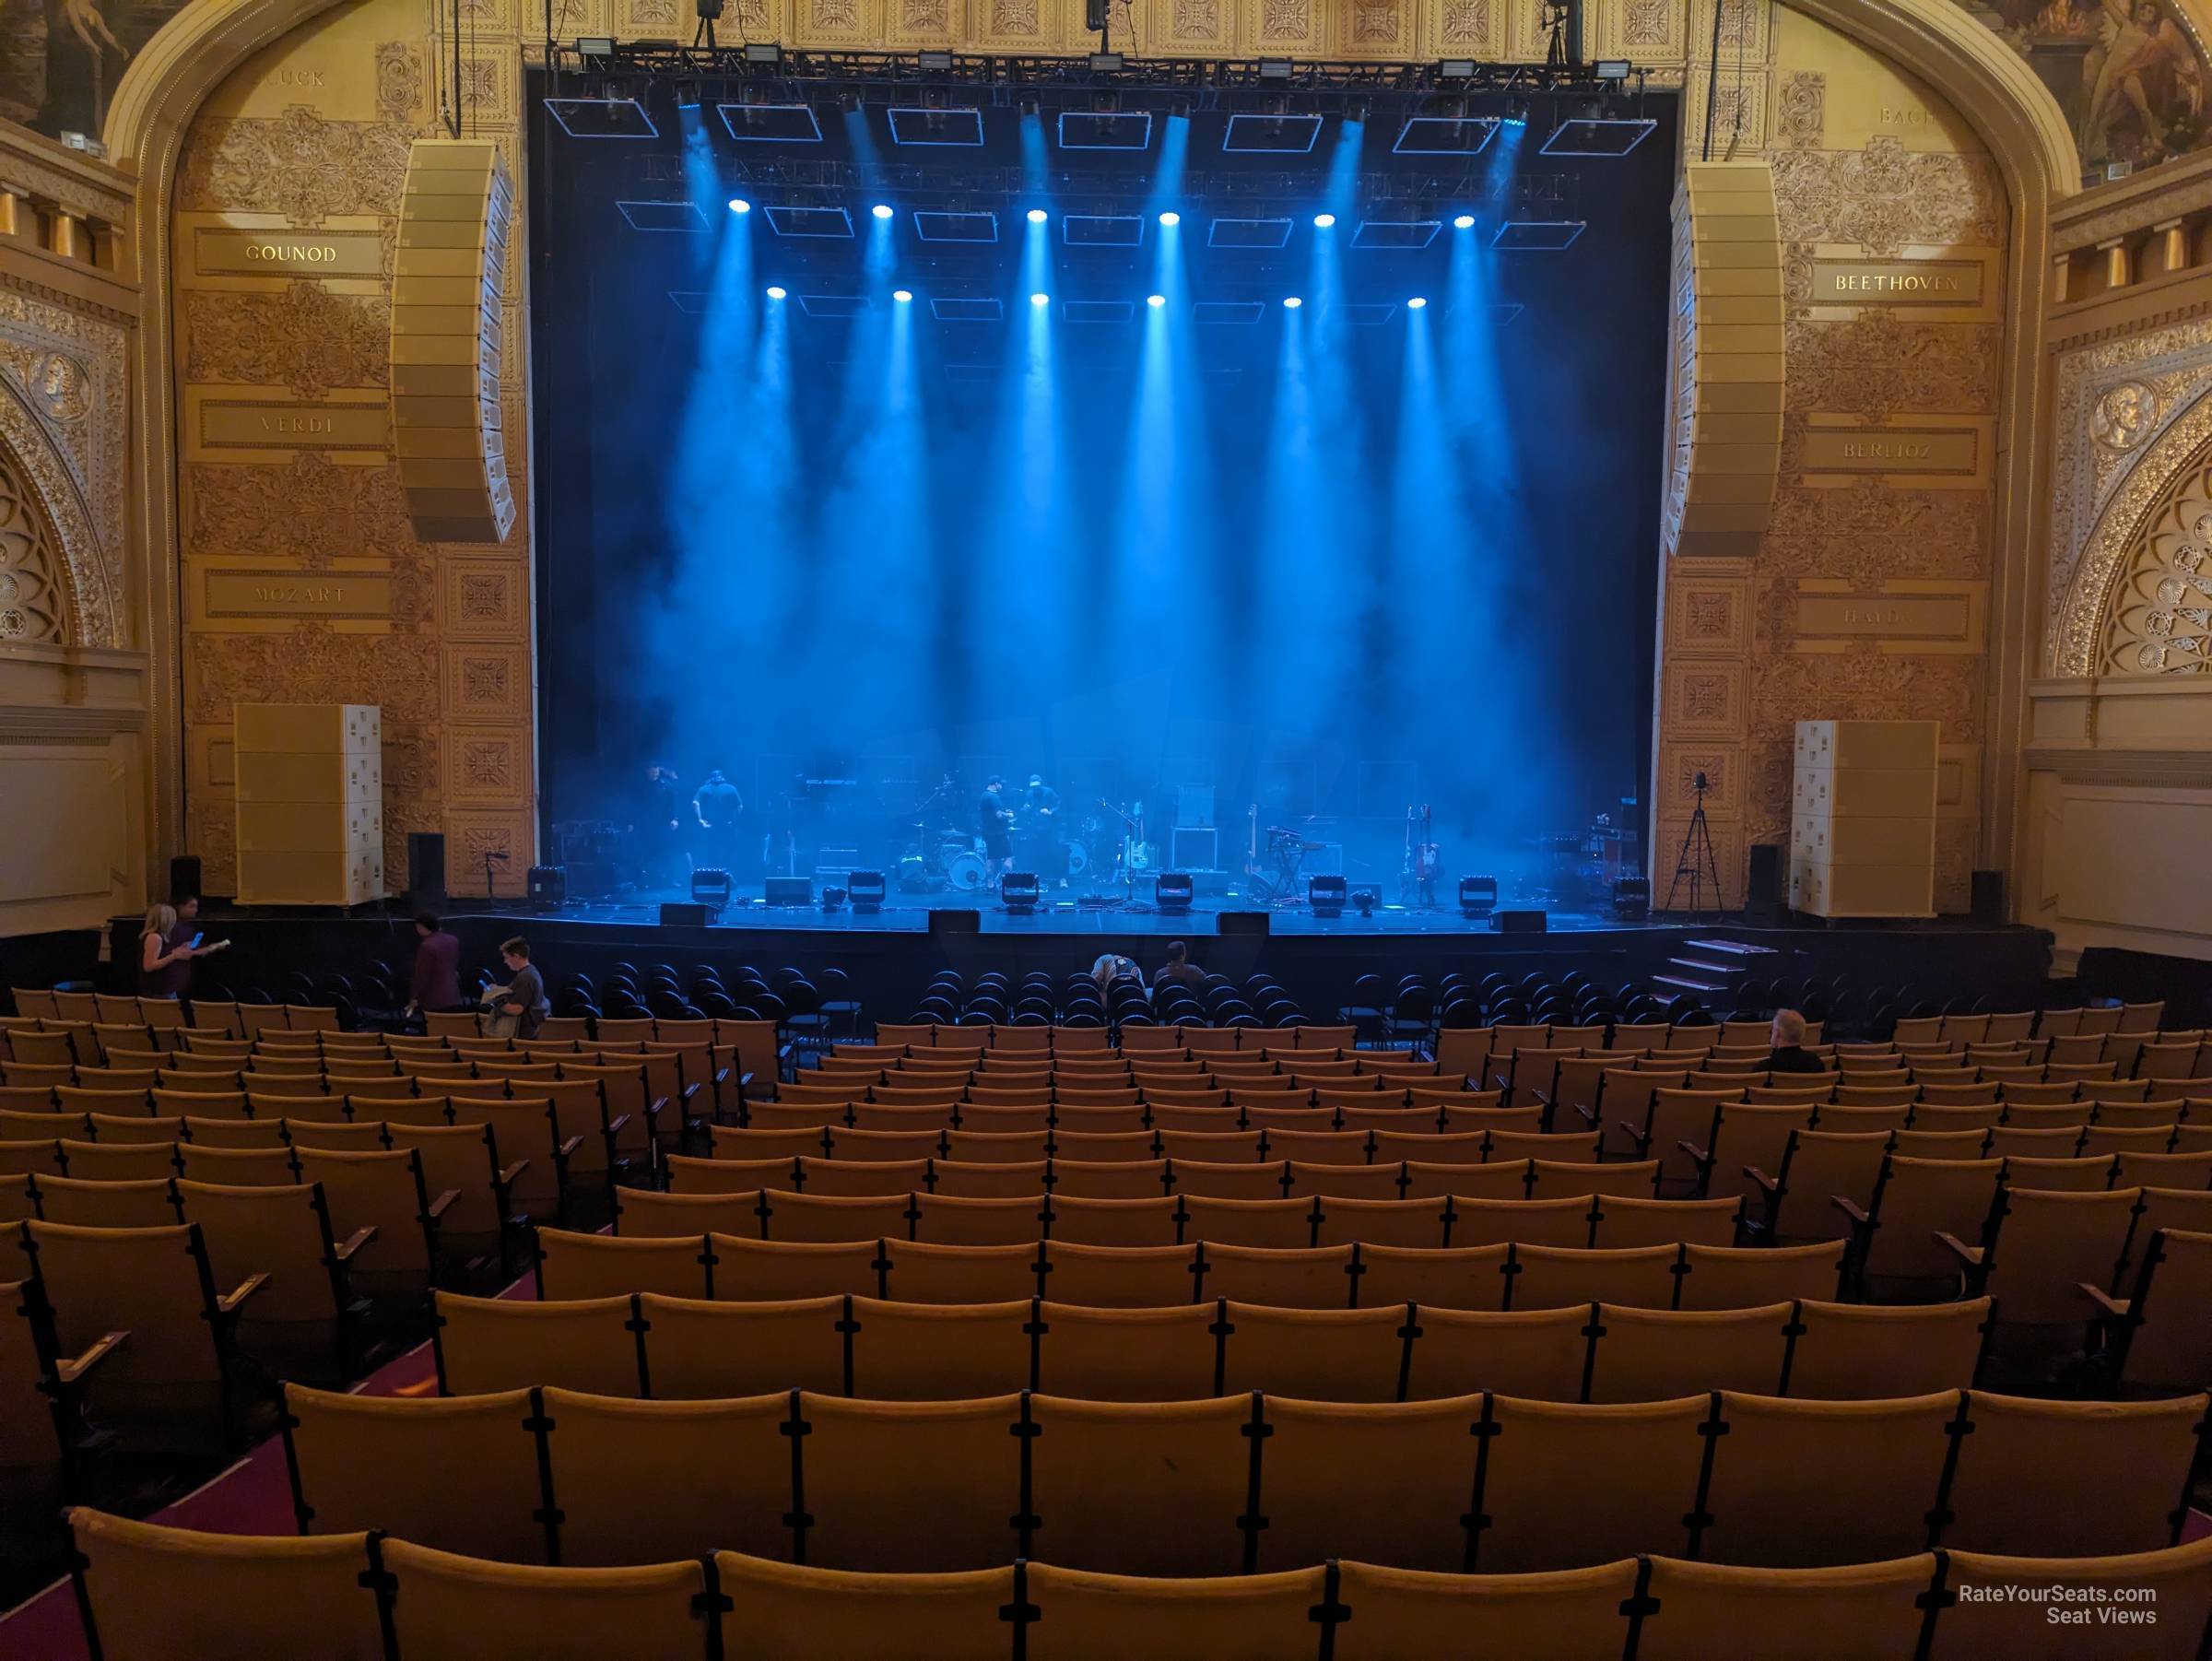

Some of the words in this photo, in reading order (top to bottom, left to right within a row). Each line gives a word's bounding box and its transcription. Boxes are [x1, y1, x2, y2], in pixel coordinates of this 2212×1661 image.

[246, 245, 336, 262] GOUNOD
[1835, 275, 1959, 291] BEETHOVEN
[1843, 442, 1932, 459] BERLIOZ
[255, 587, 346, 603] MOZART
